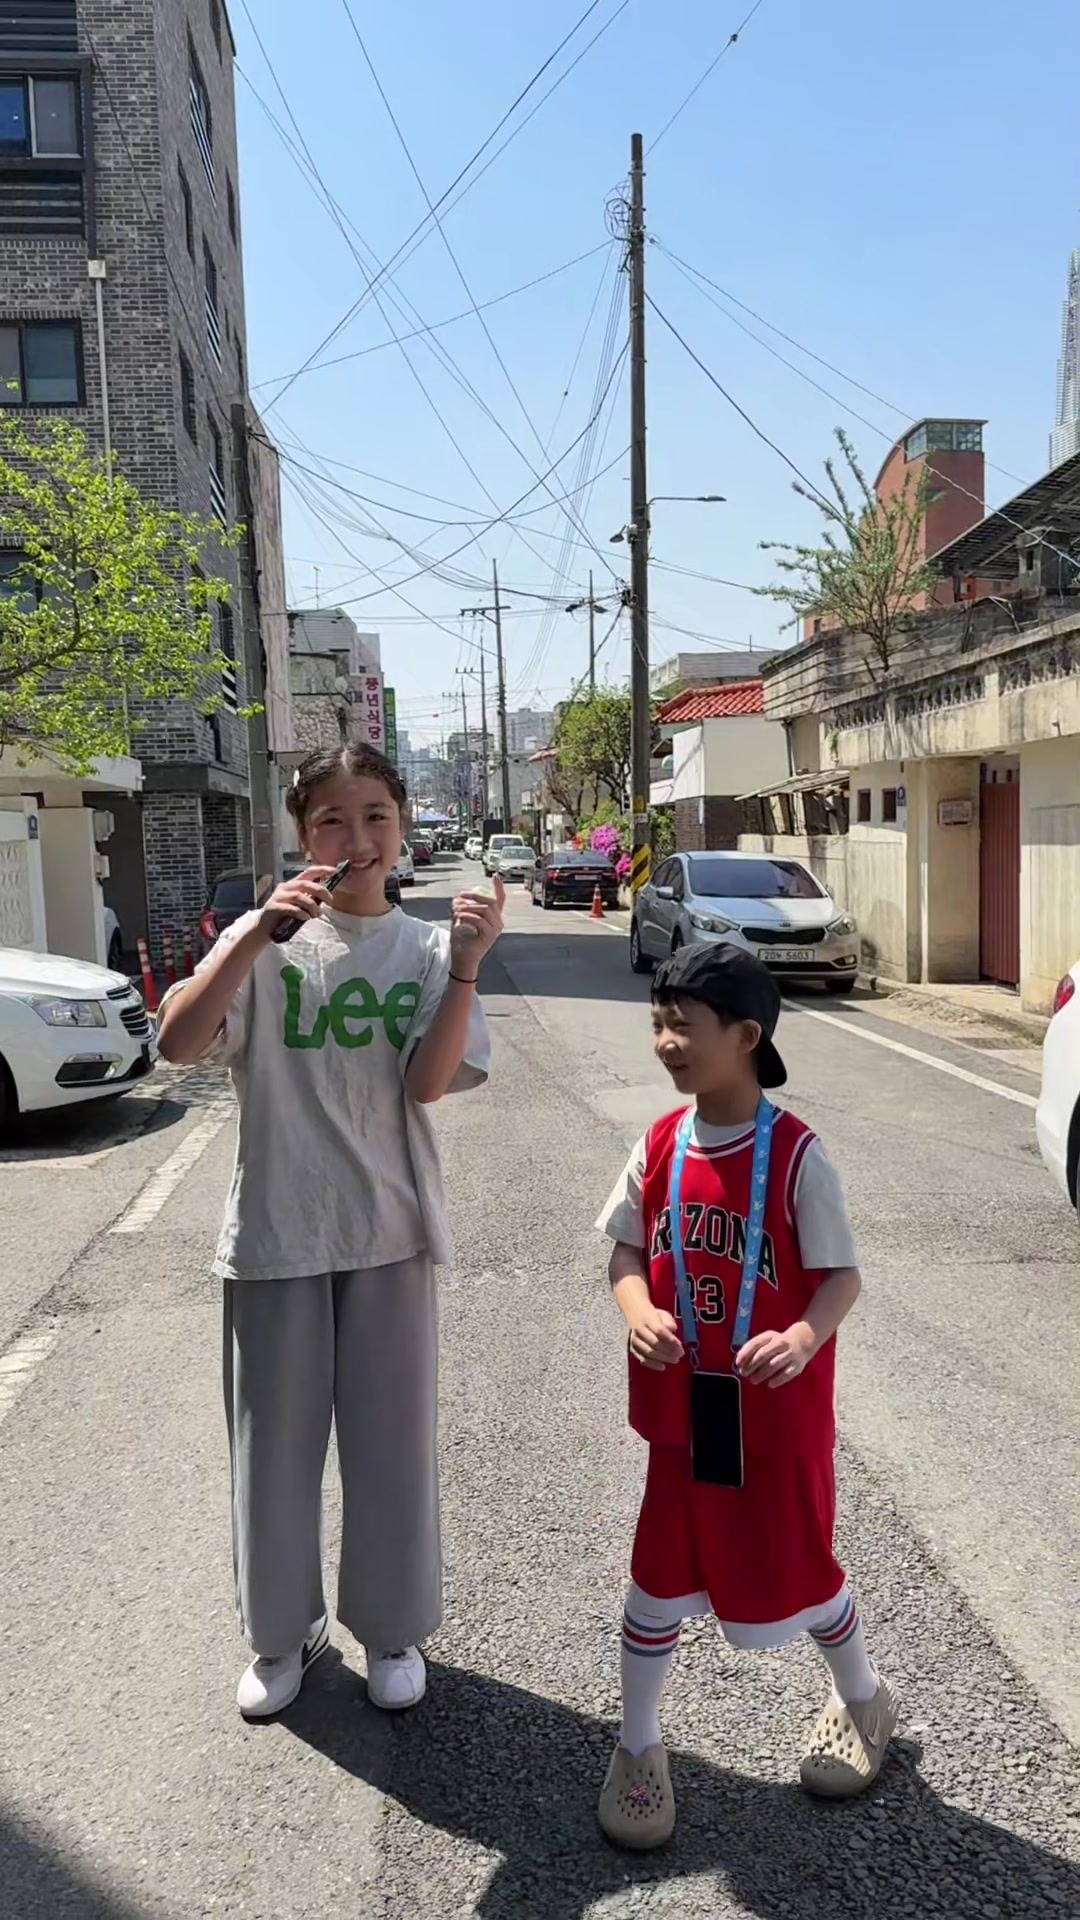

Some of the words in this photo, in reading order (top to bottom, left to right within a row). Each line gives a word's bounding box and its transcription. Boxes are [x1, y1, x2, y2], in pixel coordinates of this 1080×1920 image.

[366, 677, 381, 740] 풍년식당
[280, 965, 421, 1050] Lee
[650, 1202, 778, 1291] RZONA
